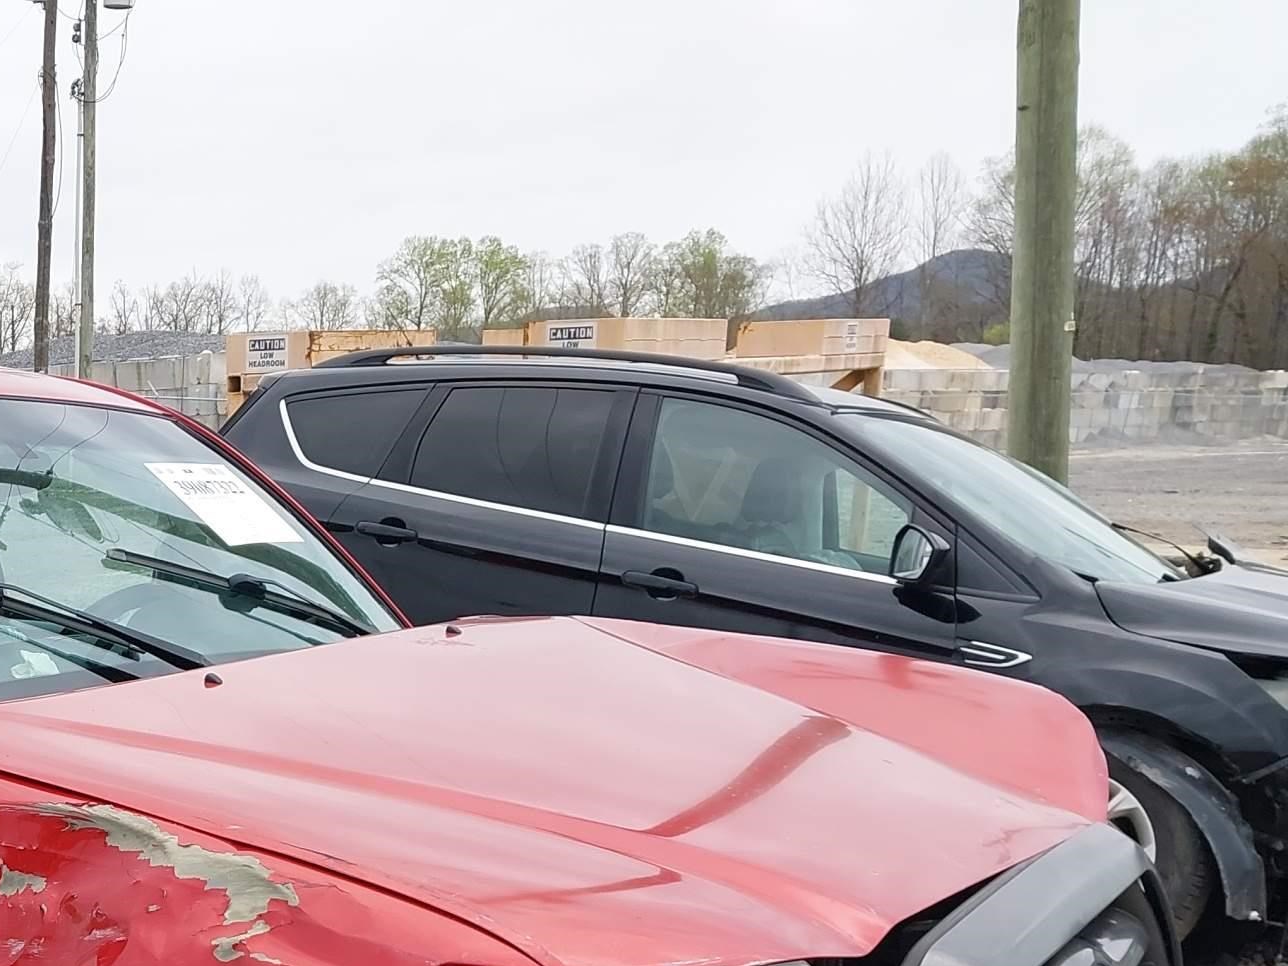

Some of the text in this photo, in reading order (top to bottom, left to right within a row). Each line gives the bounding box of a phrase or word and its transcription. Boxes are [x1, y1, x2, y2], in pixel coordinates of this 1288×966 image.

[550, 327, 593, 339] CAUTION
[249, 339, 285, 351] CAUTION
[259, 352, 274, 360] LOW
[248, 360, 285, 368] HEADROOM
